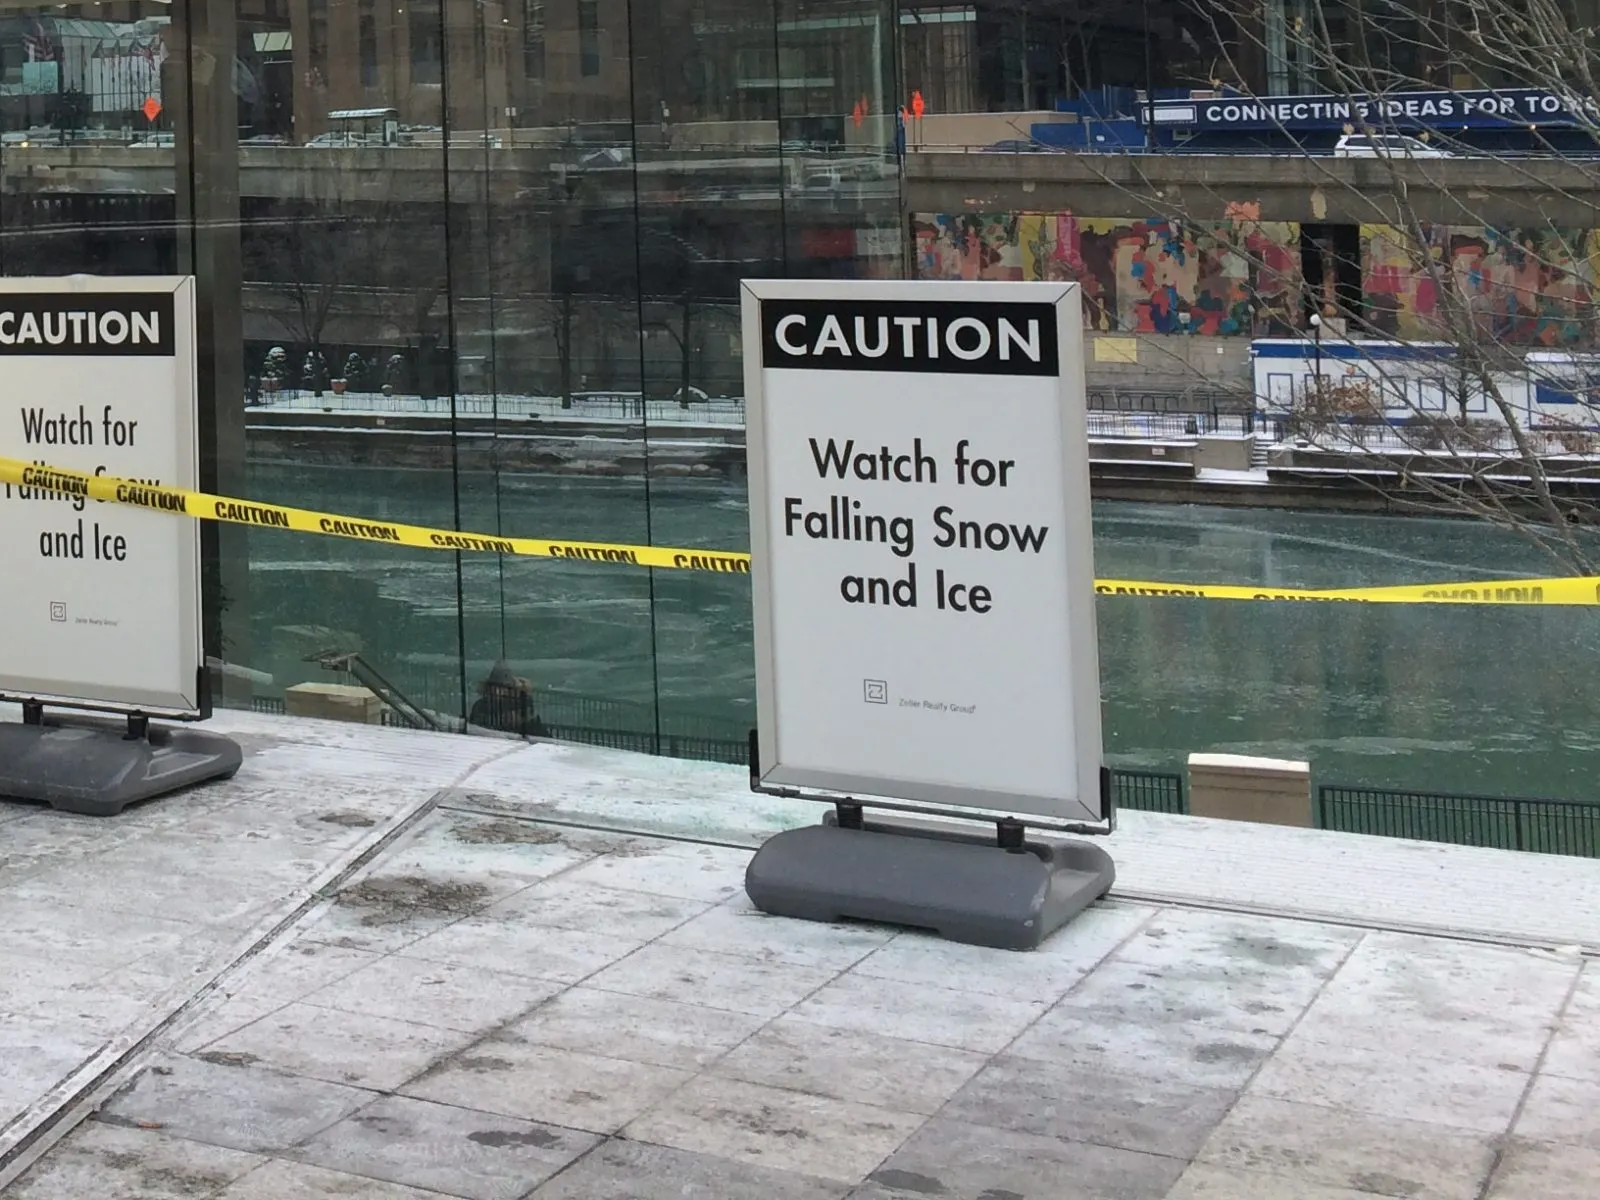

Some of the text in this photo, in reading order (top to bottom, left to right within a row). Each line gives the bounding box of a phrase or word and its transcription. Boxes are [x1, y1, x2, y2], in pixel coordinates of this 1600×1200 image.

[1206, 102, 1369, 122] CONNECTING
[1378, 99, 1454, 117] IDEAS
[1463, 96, 1515, 115] FOR
[774, 313, 1041, 363] CAUTION
[21, 404, 138, 447] Watch for
[808, 437, 1016, 487] Watch for
[22, 466, 89, 495] CAUTION
[116, 484, 187, 512] CAUTION
[215, 501, 290, 527] CAUTION
[319, 518, 400, 541] CAUTION
[430, 534, 515, 553] CAUTION
[548, 545, 638, 564] CAUTION
[673, 554, 750, 574] CAUTIO
[40, 518, 127, 562] and Ice
[784, 495, 1049, 558] Falling Snow
[840, 562, 992, 614] and Ice
